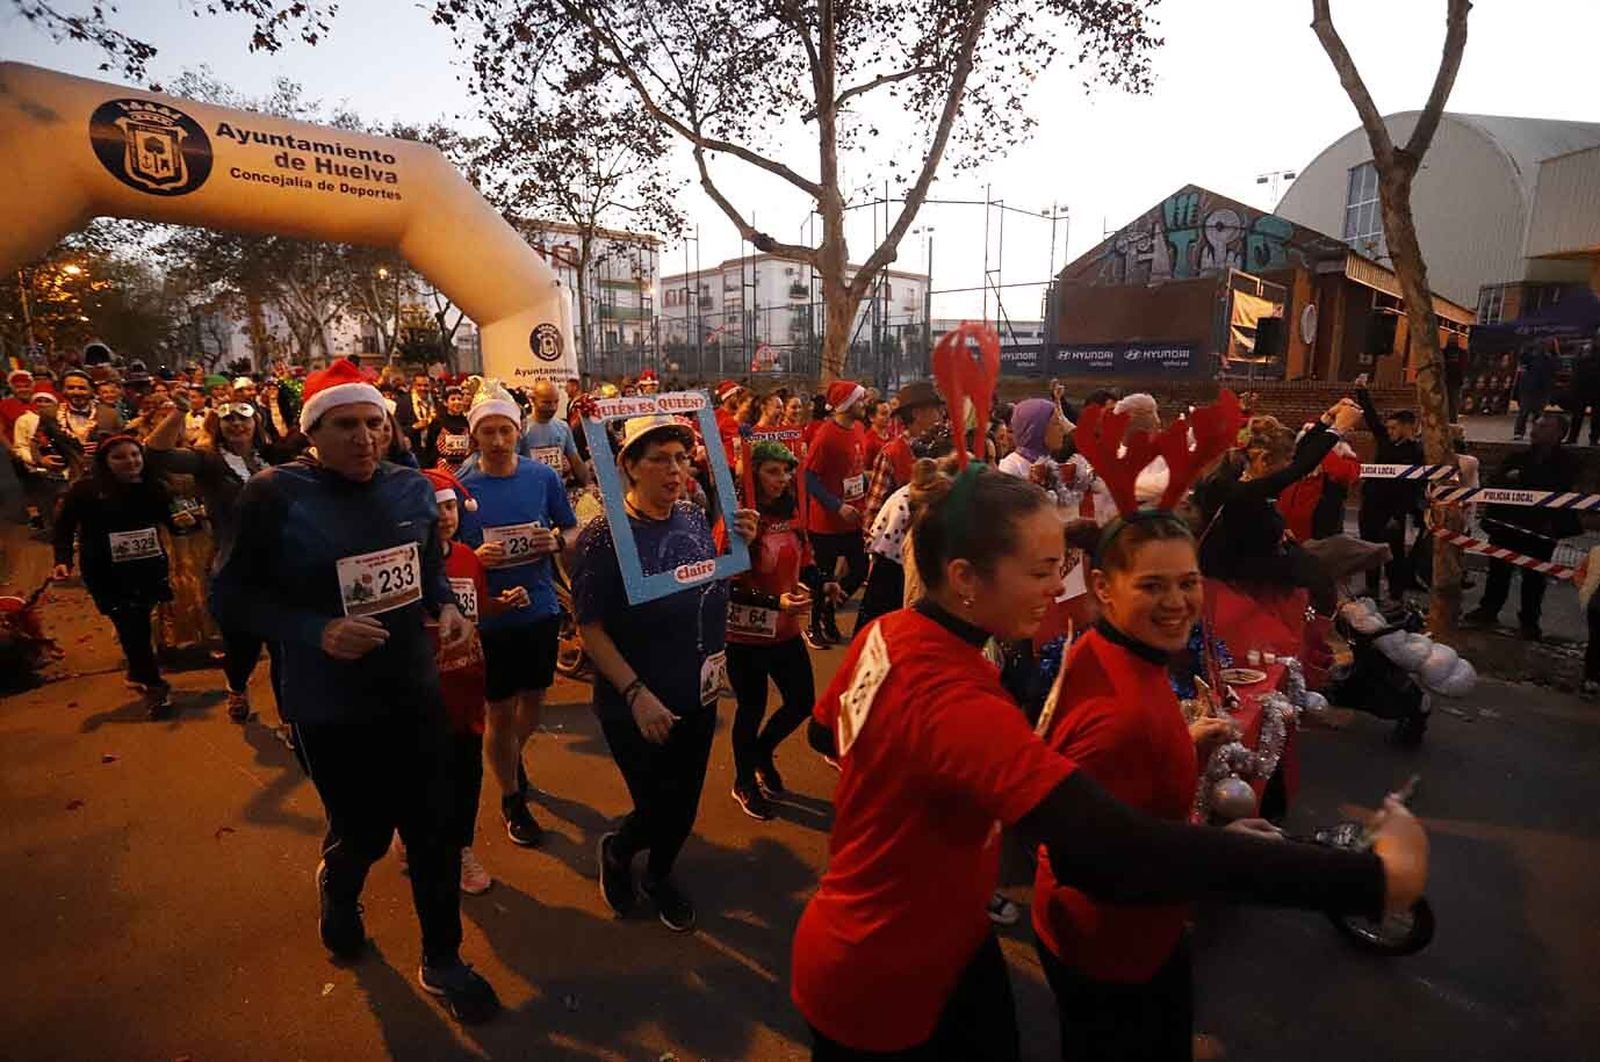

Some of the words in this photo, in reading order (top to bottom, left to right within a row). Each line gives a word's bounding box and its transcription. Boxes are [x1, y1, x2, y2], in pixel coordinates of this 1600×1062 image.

[216, 122, 396, 165] Ayuntamiento
[275, 152, 306, 171] de
[315, 157, 398, 184] Huelva
[318, 180, 335, 192] de
[340, 183, 402, 201] Deportes
[1001, 352, 1037, 361] HYUNDAI
[1072, 351, 1114, 361] HYUNDAI
[1143, 350, 1190, 360] HYUNDAI
[639, 403, 655, 413] ES
[658, 395, 703, 410] QUIÉN?
[1378, 467, 1396, 475] LOCAL
[1484, 491, 1510, 502] POLICIA
[1512, 492, 1534, 503] LOCAL
[379, 563, 414, 594] 233
[749, 610, 767, 625] 64
